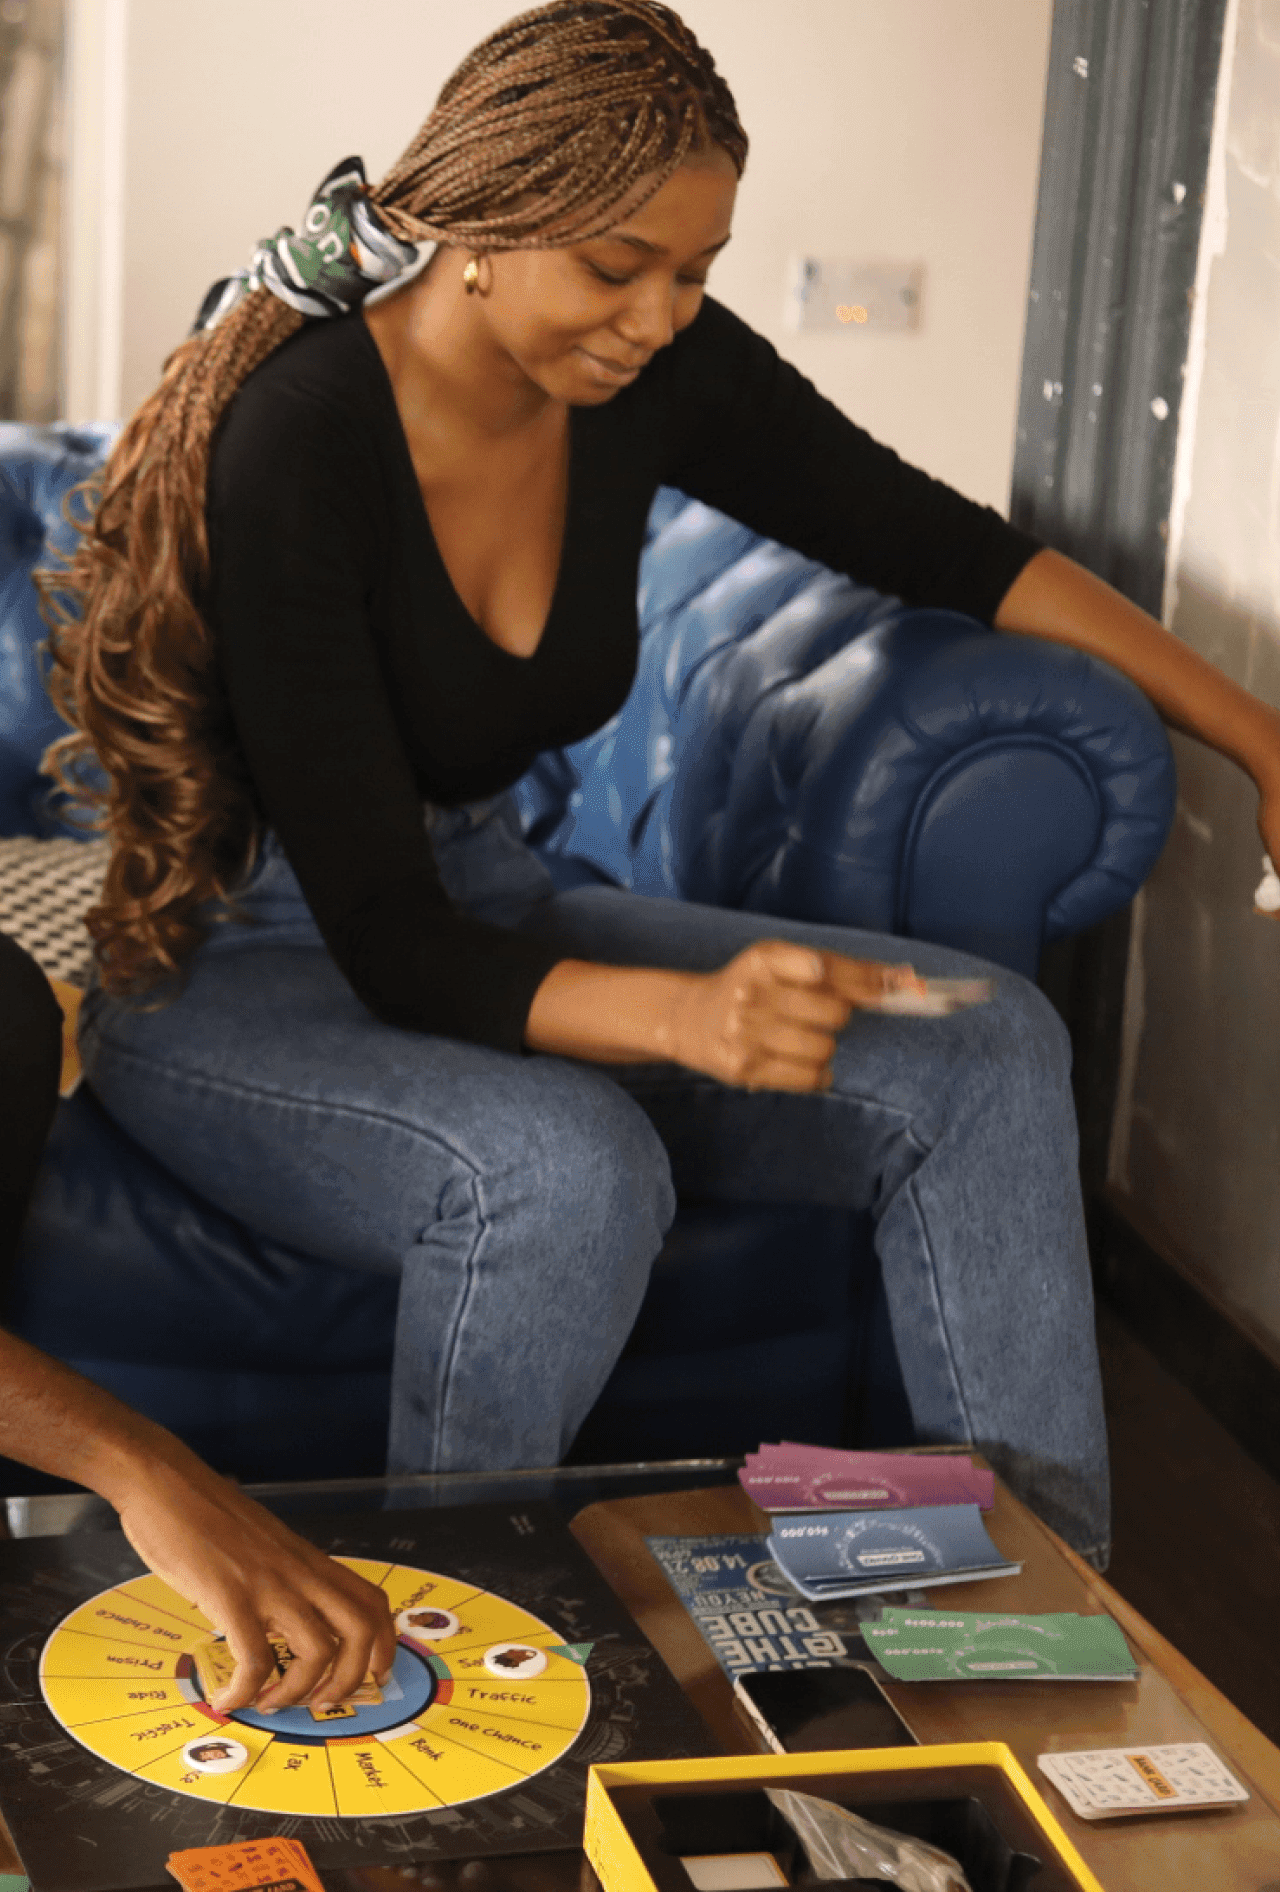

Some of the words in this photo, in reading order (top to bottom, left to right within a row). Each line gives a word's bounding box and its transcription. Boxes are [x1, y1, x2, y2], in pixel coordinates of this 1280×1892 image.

[700, 1608, 820, 1639] CUBE
[715, 1632, 847, 1666] @THE
[106, 1654, 163, 1670] Prison
[127, 1690, 167, 1700] Ride
[467, 1688, 537, 1705] Traffic
[130, 1718, 196, 1741] Traffic
[409, 1738, 446, 1761] Bank
[284, 1753, 309, 1771] Tax
[354, 1752, 388, 1788] Market
